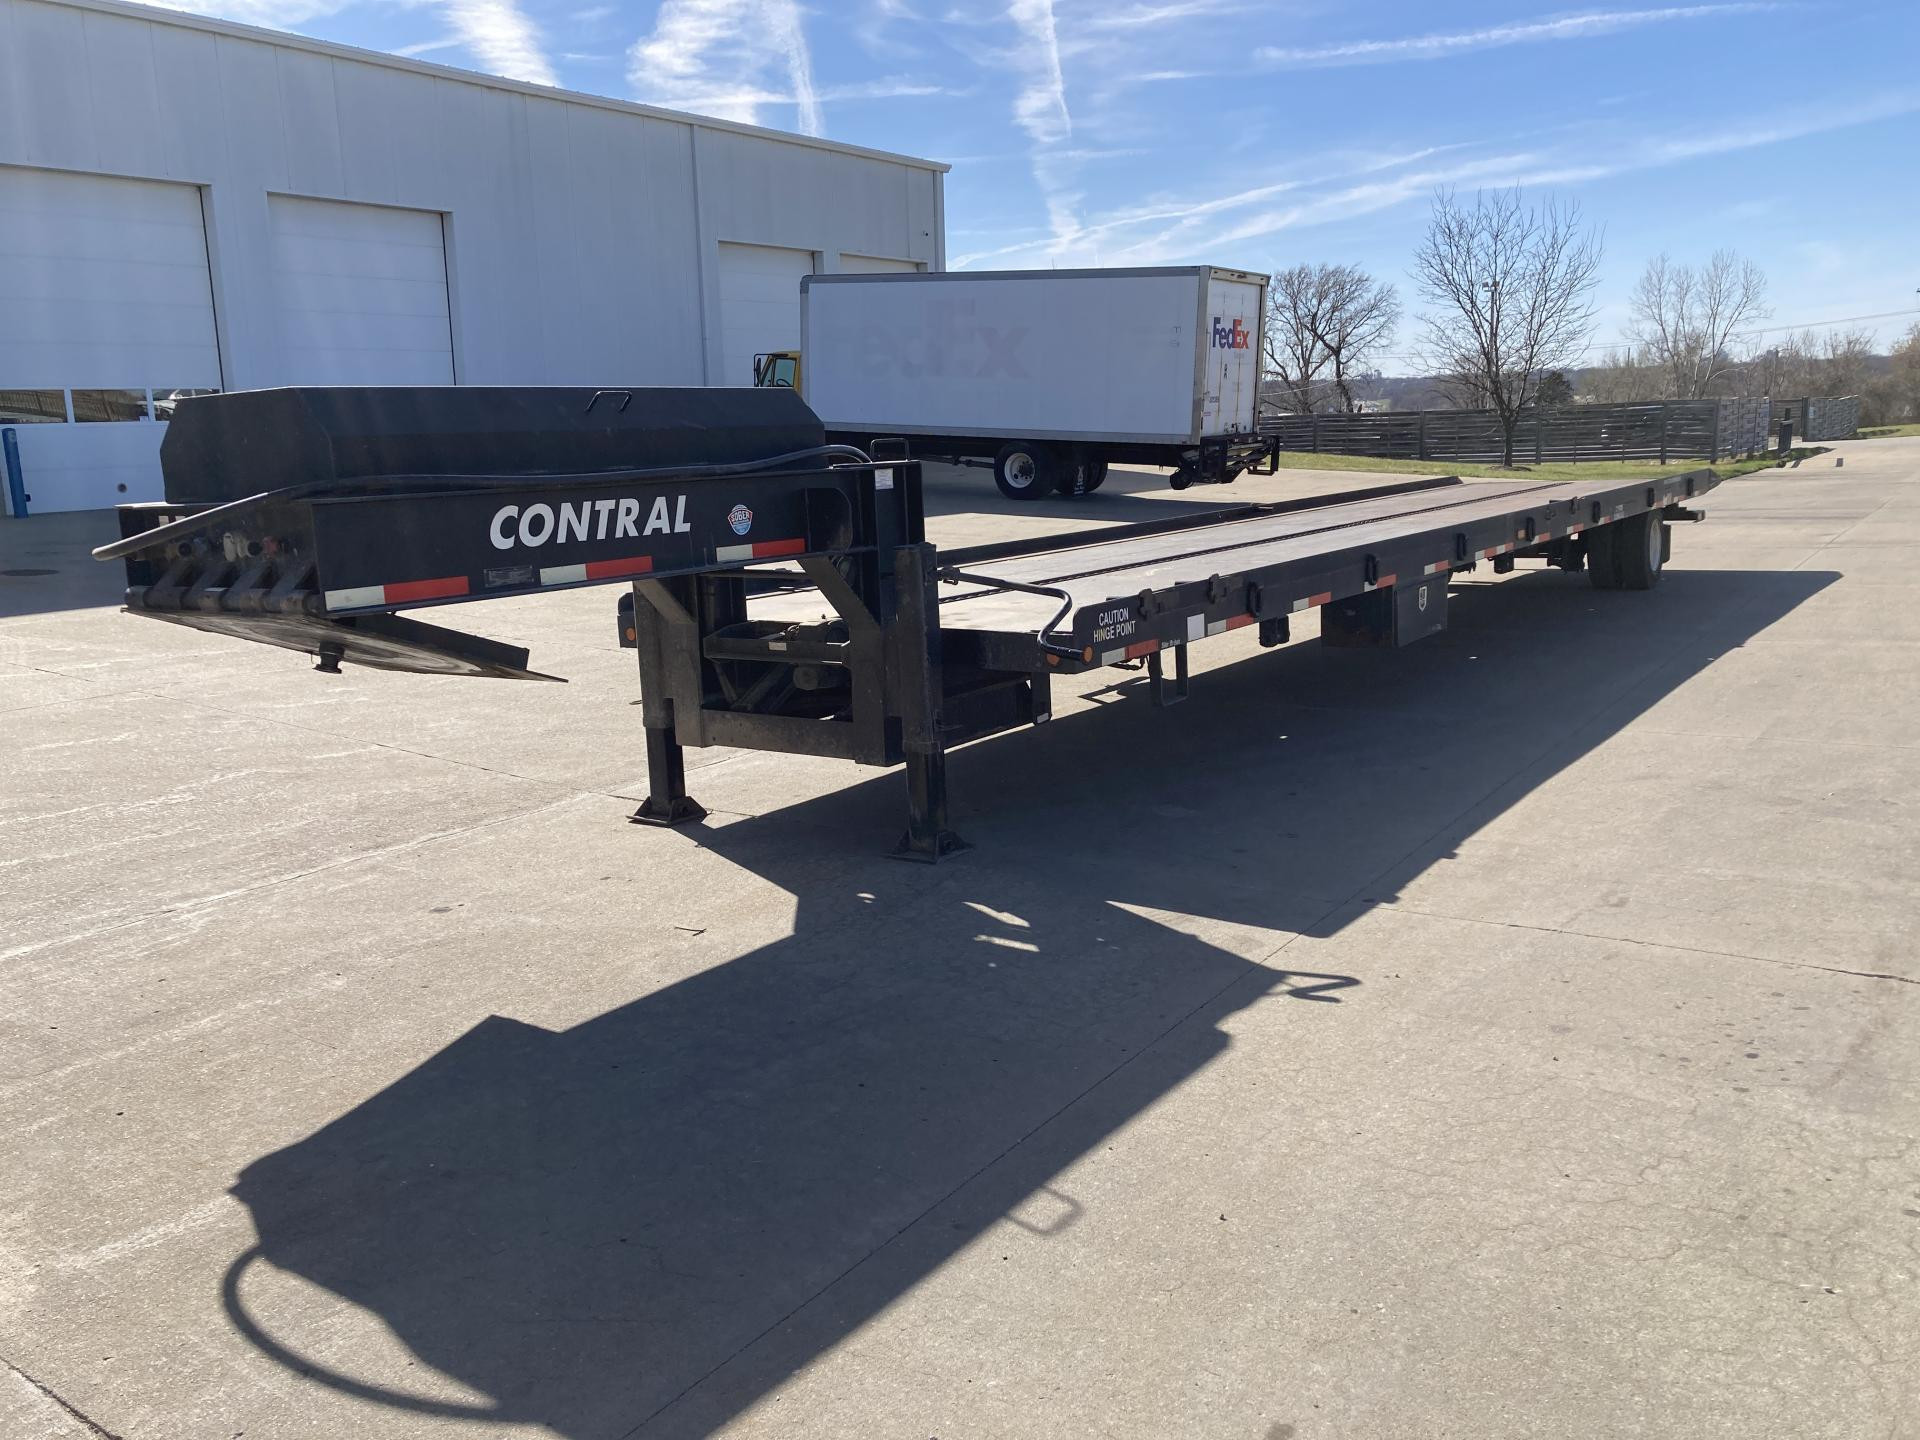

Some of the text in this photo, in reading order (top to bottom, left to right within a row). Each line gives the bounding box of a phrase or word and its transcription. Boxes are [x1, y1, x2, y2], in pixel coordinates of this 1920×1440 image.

[1212, 316, 1250, 349] FedEx
[489, 495, 691, 550] CONTRAL
[1099, 608, 1129, 626] CAUTION
[1093, 620, 1136, 643] HINGE POINT
